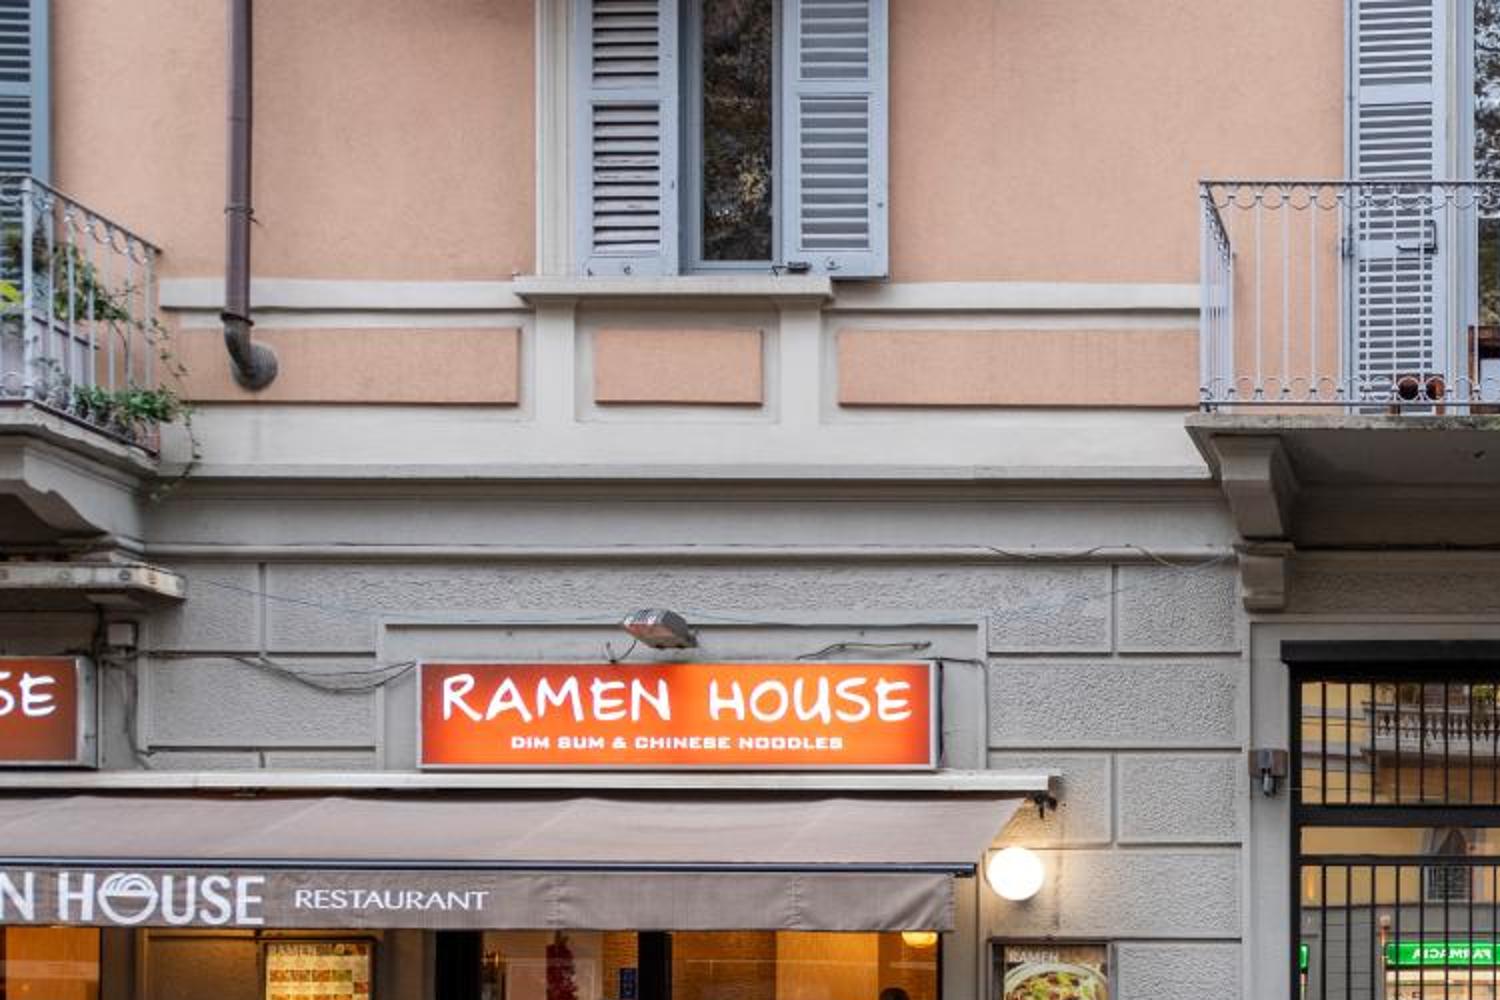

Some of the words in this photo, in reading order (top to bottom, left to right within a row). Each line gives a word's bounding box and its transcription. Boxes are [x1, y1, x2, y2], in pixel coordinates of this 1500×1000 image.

[442, 673, 672, 723] RAMEN
[708, 676, 914, 724] HOUSE
[511, 735, 550, 750] DIM
[557, 735, 605, 750] SUM
[613, 735, 627, 750] &
[634, 735, 731, 750] CHINESE
[738, 735, 844, 750] NOODLES
[57, 872, 266, 926] HOUSE
[294, 889, 490, 911] RESTAURANT
